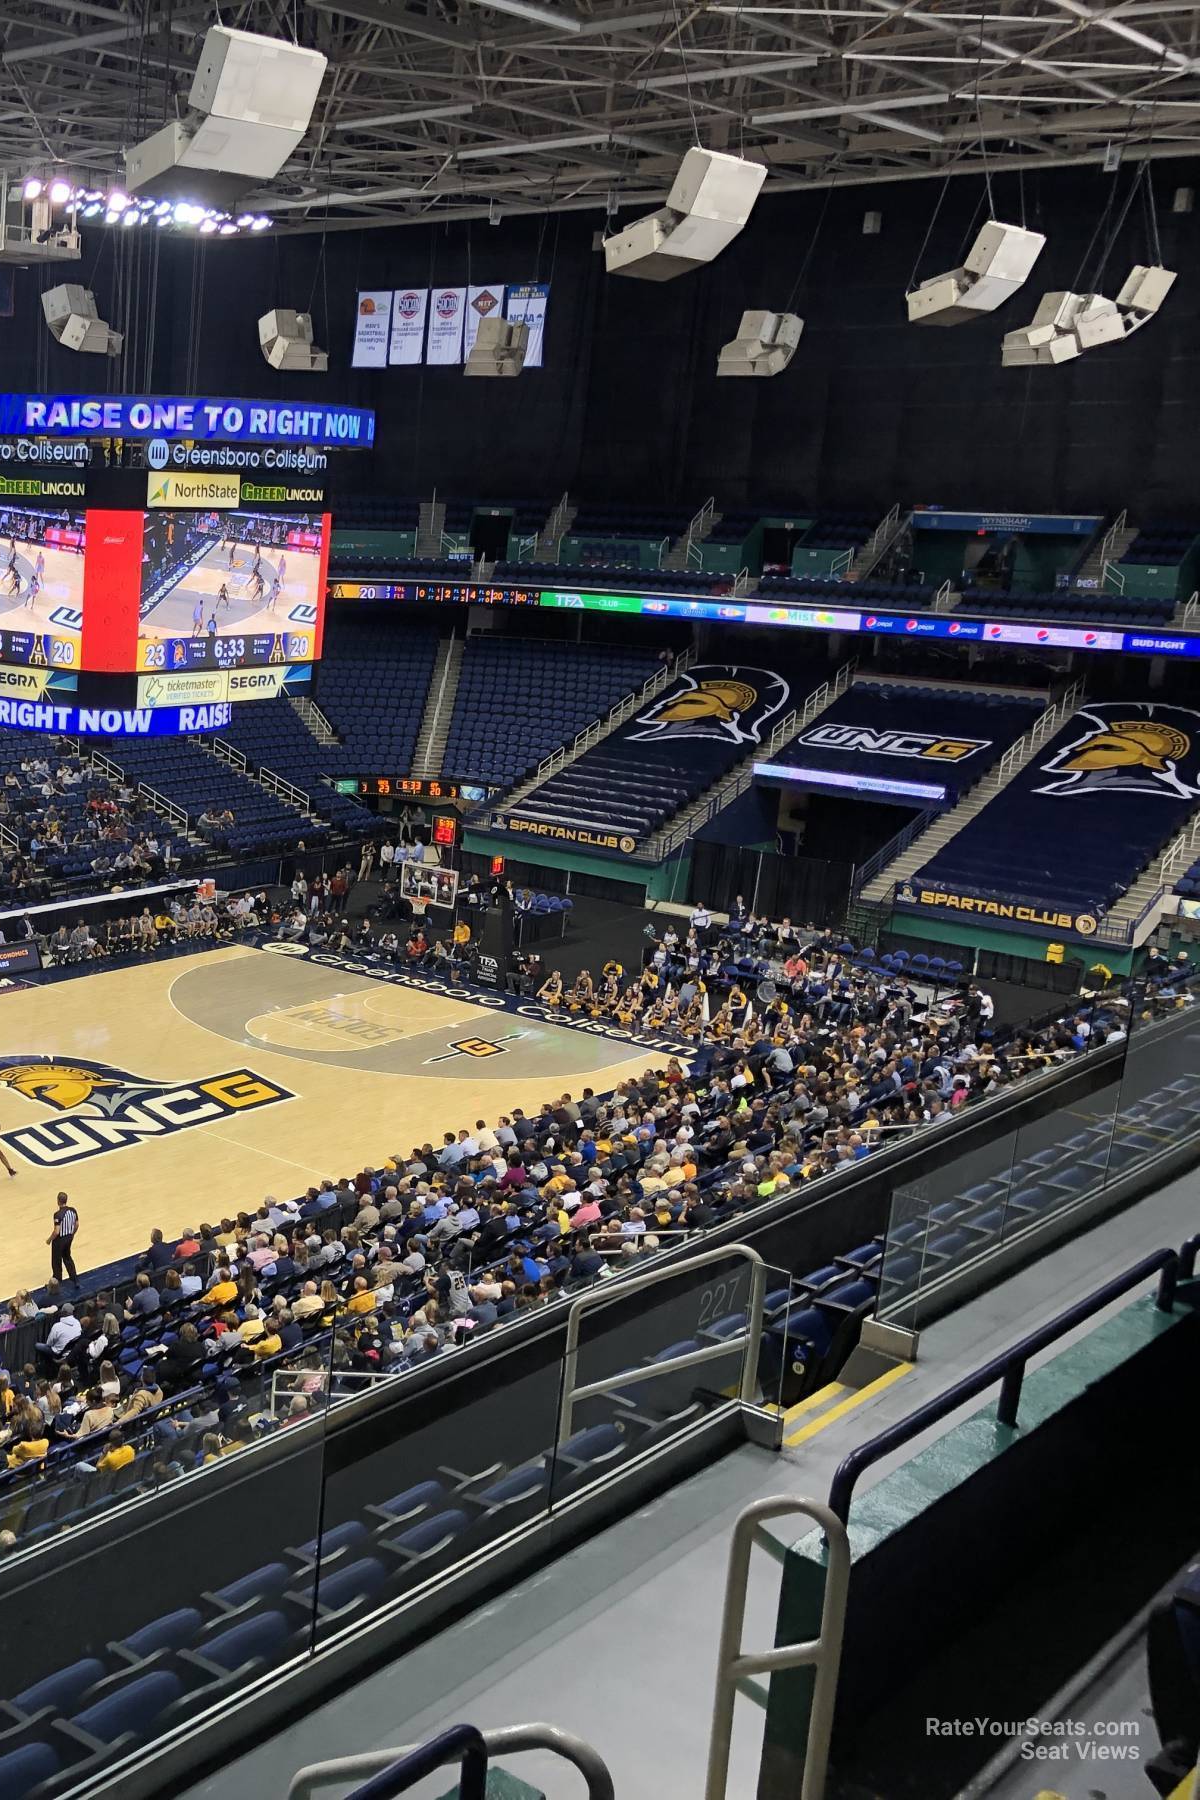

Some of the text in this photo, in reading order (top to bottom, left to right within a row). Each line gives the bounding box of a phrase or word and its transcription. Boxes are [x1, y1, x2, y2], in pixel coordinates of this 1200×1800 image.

[25, 402, 122, 429] RAISE
[129, 403, 195, 431] ONE
[204, 406, 244, 433] TO
[250, 408, 322, 437] RIGHT
[325, 413, 360, 440] NOW
[16, 442, 89, 460] Coliseum
[172, 445, 327, 469] Greensboro Coliseum
[41, 482, 85, 496] LINCOLN
[174, 482, 238, 500] NorthState
[240, 482, 323, 502] GREEN LINCOLN
[359, 587, 376, 600] 20
[419, 589, 425, 597] 0
[445, 590, 451, 598] 2
[470, 590, 476, 599] 4
[493, 592, 503, 600] 20
[517, 593, 527, 602] 50
[554, 593, 585, 608] TFA
[877, 621, 893, 629] pepsi
[917, 623, 934, 631] pepsi
[960, 627, 978, 635] pepsi
[214, 638, 245, 658] 6:33
[290, 636, 309, 657] 20
[1132, 638, 1186, 650] BUD LIGHT
[52, 641, 75, 664] 20
[144, 644, 166, 667] 23
[166, 679, 217, 692] ticketmaster
[230, 675, 277, 690] SEGRA
[191, 690, 214, 699] TICKETS
[78, 708, 153, 734] NOW
[179, 702, 229, 732] RAISE
[803, 725, 981, 760] UNCG
[362, 783, 367, 792] 3
[378, 784, 390, 793] 23
[402, 780, 421, 790] 6:33
[430, 787, 440, 796] 20
[451, 788, 456, 797] 3
[509, 819, 576, 840] SPARTAN
[577, 832, 618, 848] CLUB
[920, 890, 1072, 929] SPARTAN CLUB
[479, 955, 498, 968] TFA
[310, 953, 699, 1057] Greensboro Coliseum
[6, 1073, 284, 1164] UNCG
[698, 1276, 740, 1323] 227
